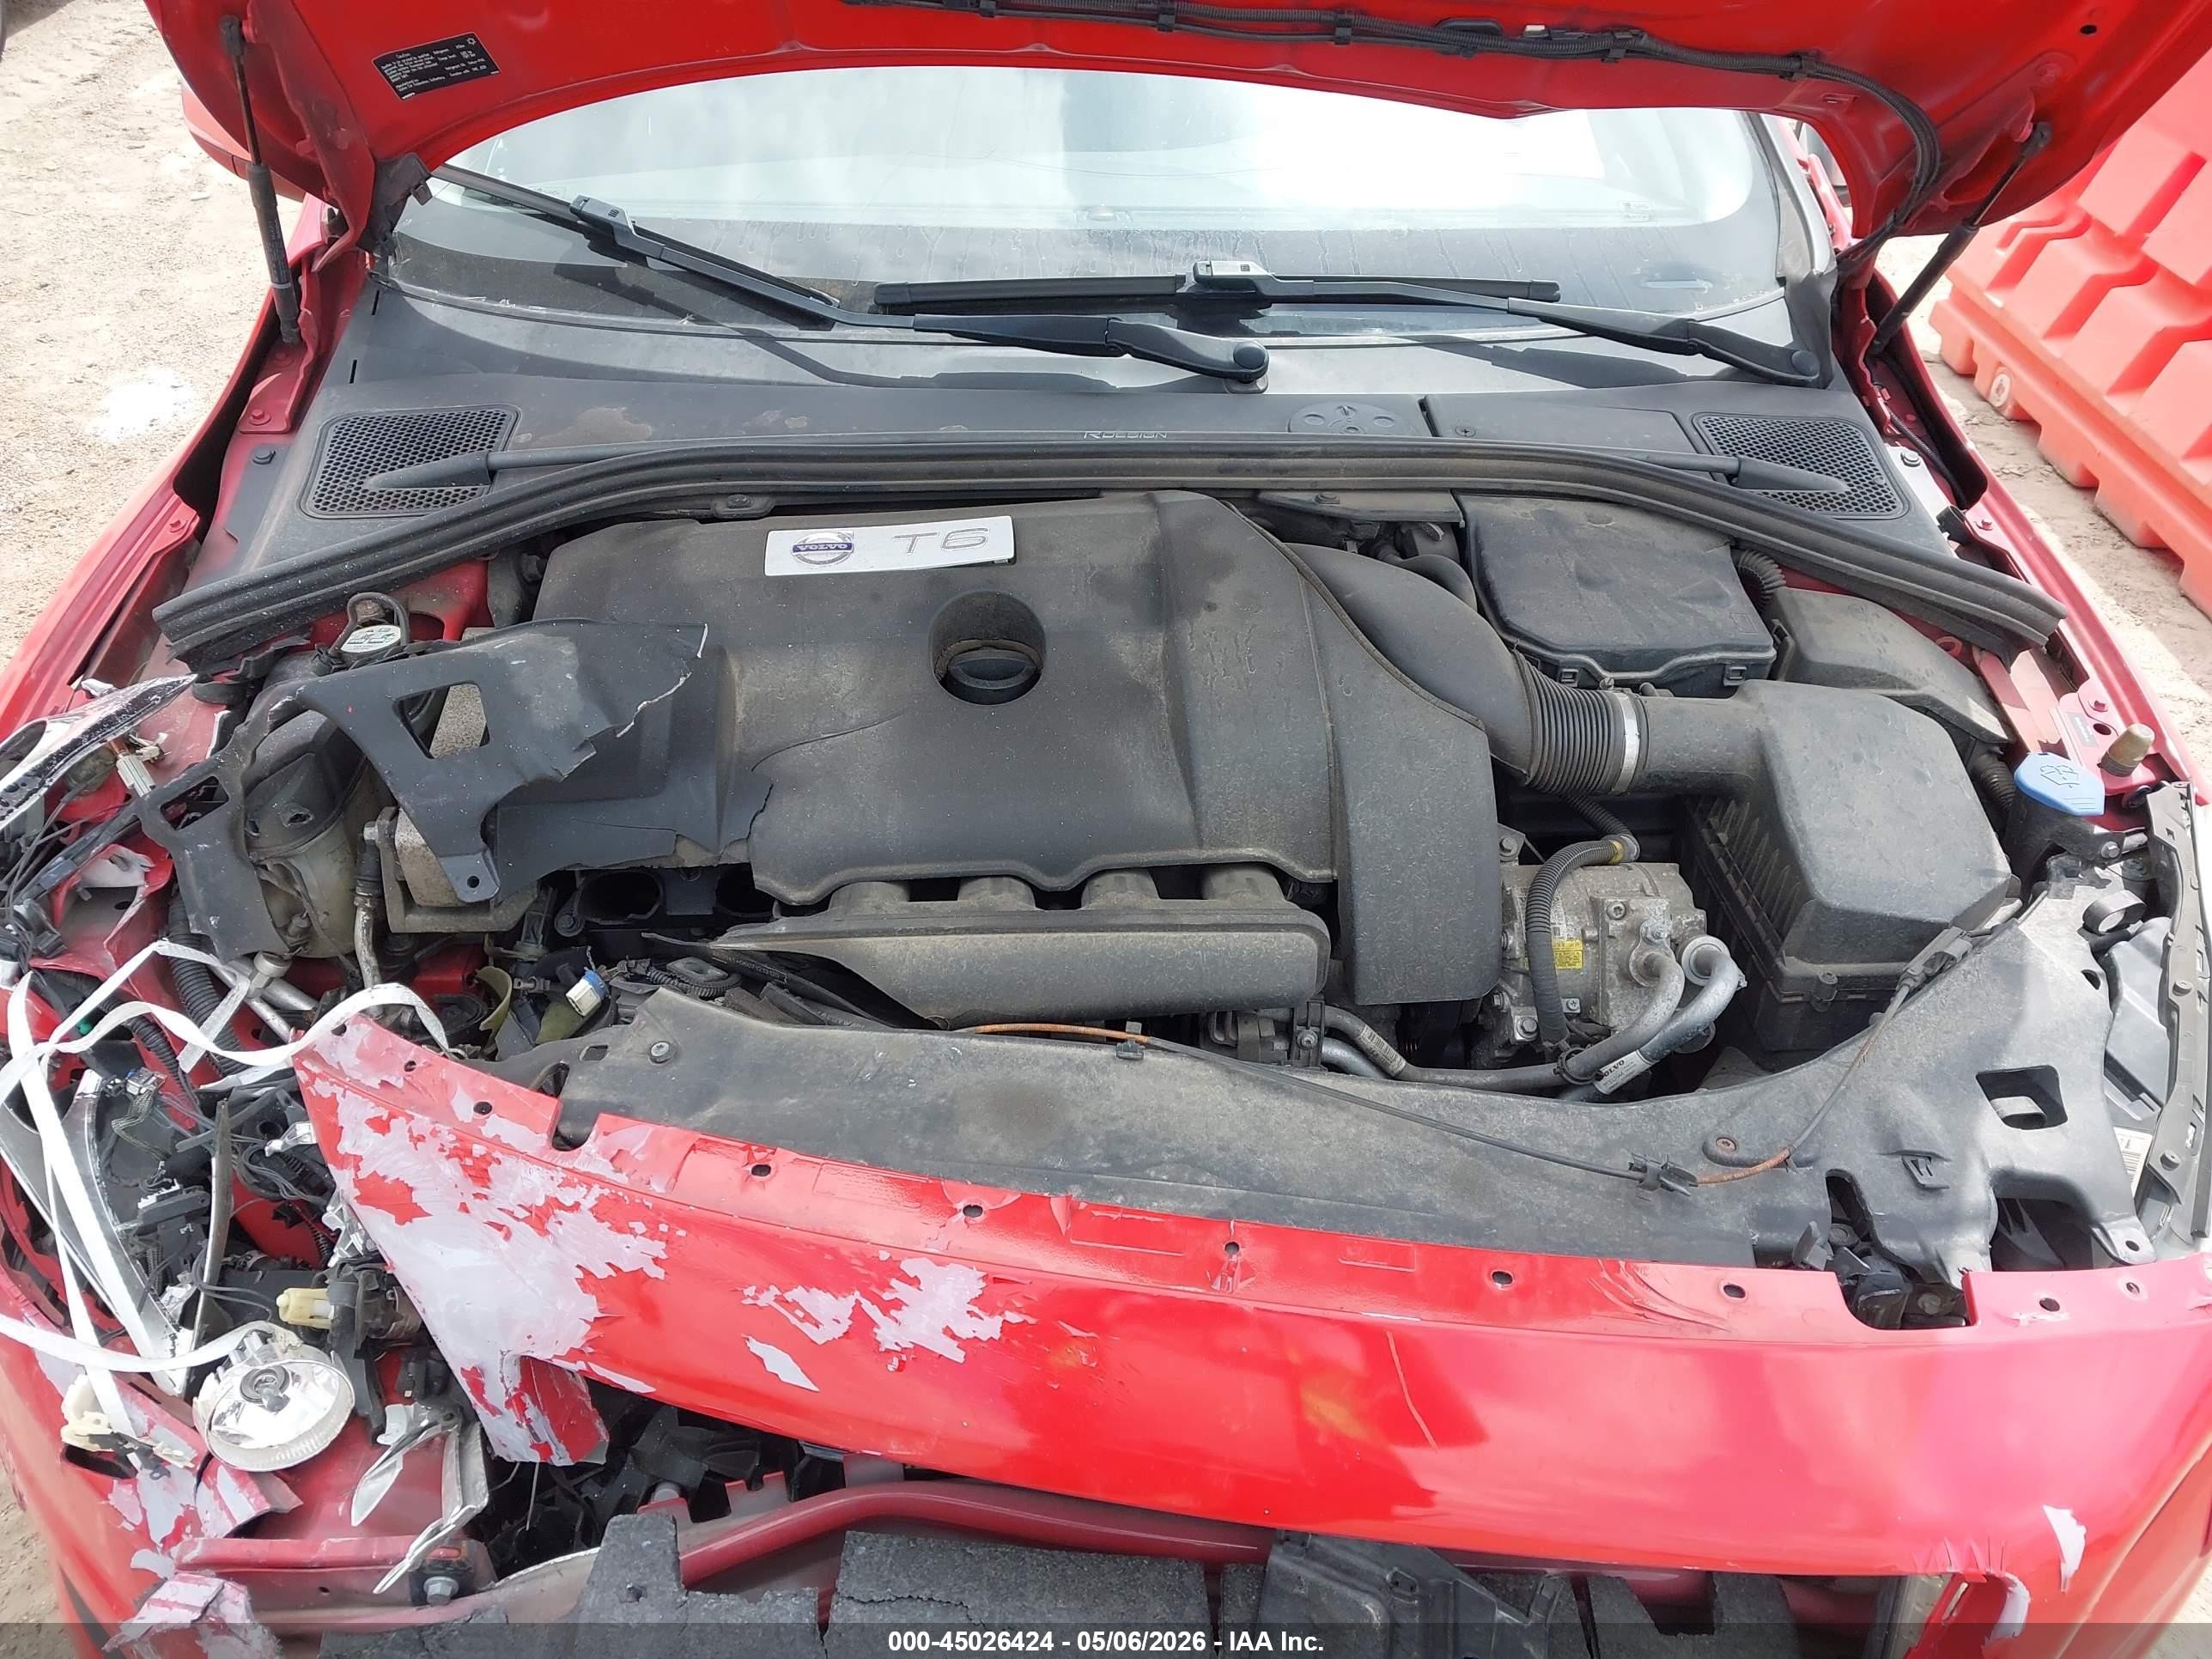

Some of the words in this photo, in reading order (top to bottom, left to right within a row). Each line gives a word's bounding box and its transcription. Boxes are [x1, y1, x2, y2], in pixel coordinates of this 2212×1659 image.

[795, 543, 849, 552] VOLVO
[891, 526, 989, 556] T6
[1603, 1059, 1626, 1078] OLVO
